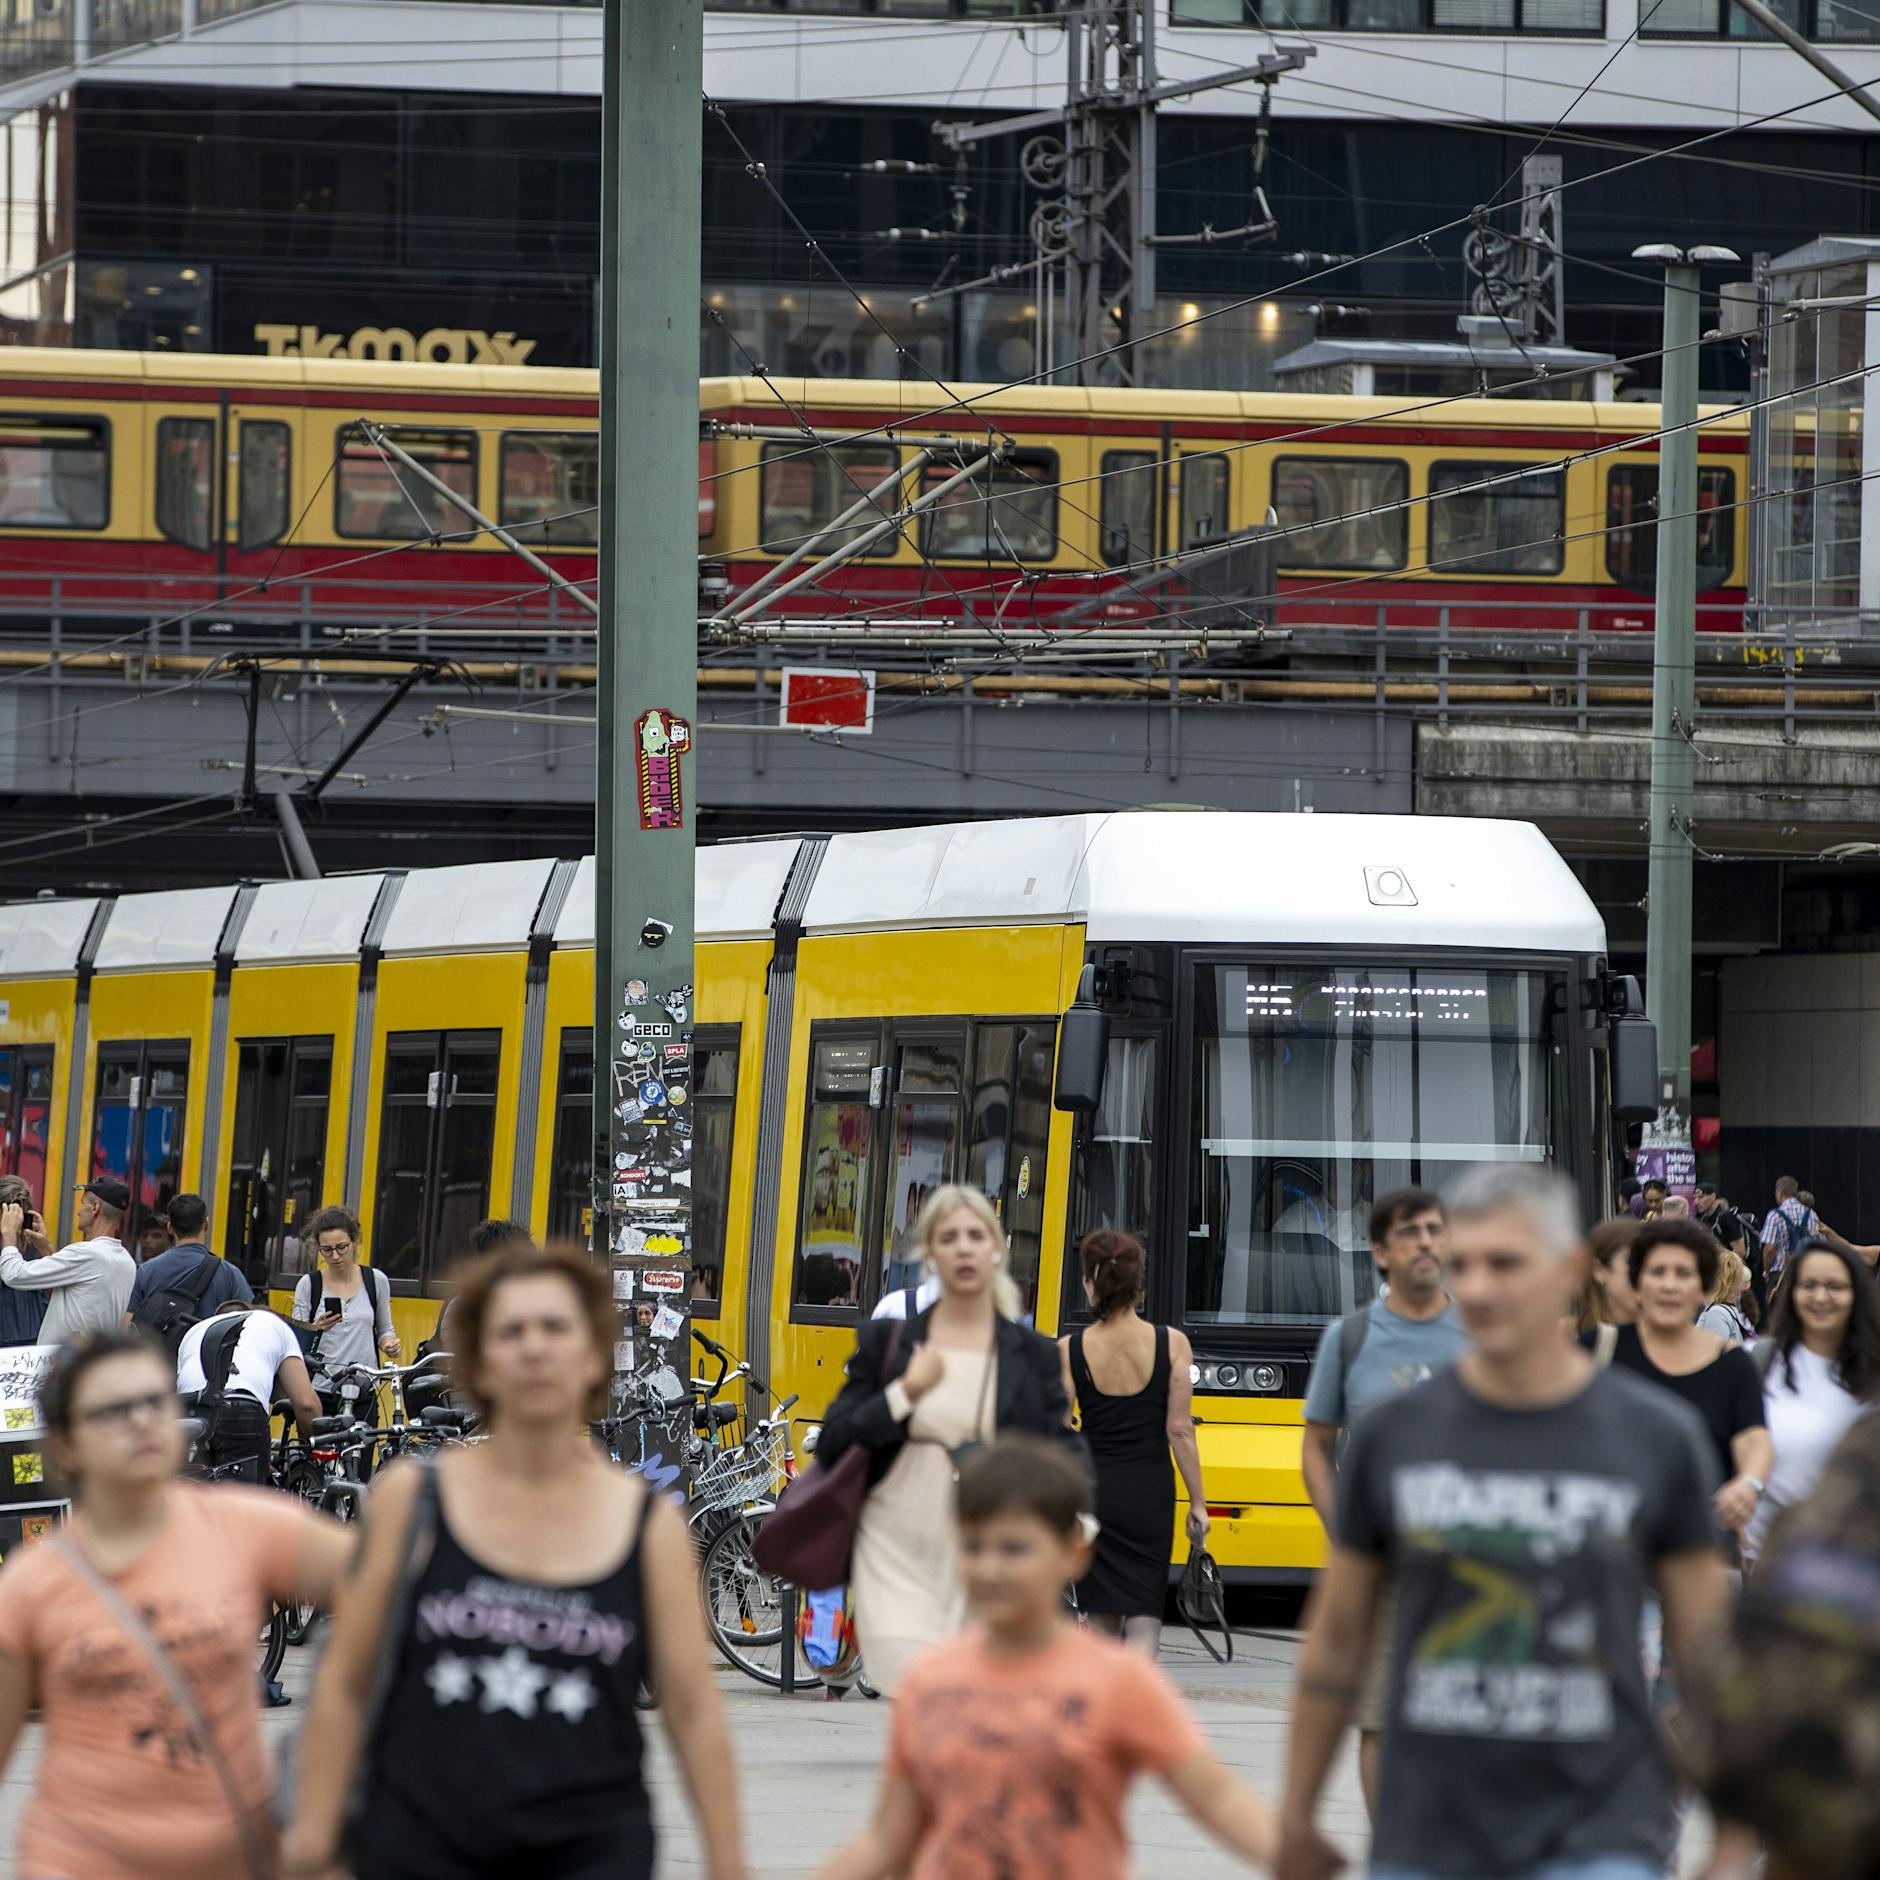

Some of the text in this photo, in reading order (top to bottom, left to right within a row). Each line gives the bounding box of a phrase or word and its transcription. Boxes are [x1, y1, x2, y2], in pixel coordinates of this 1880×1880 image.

[667, 1047, 685, 1055] SPLA
[1667, 1163, 1689, 1173] after
[1667, 1173, 1684, 1183] the
